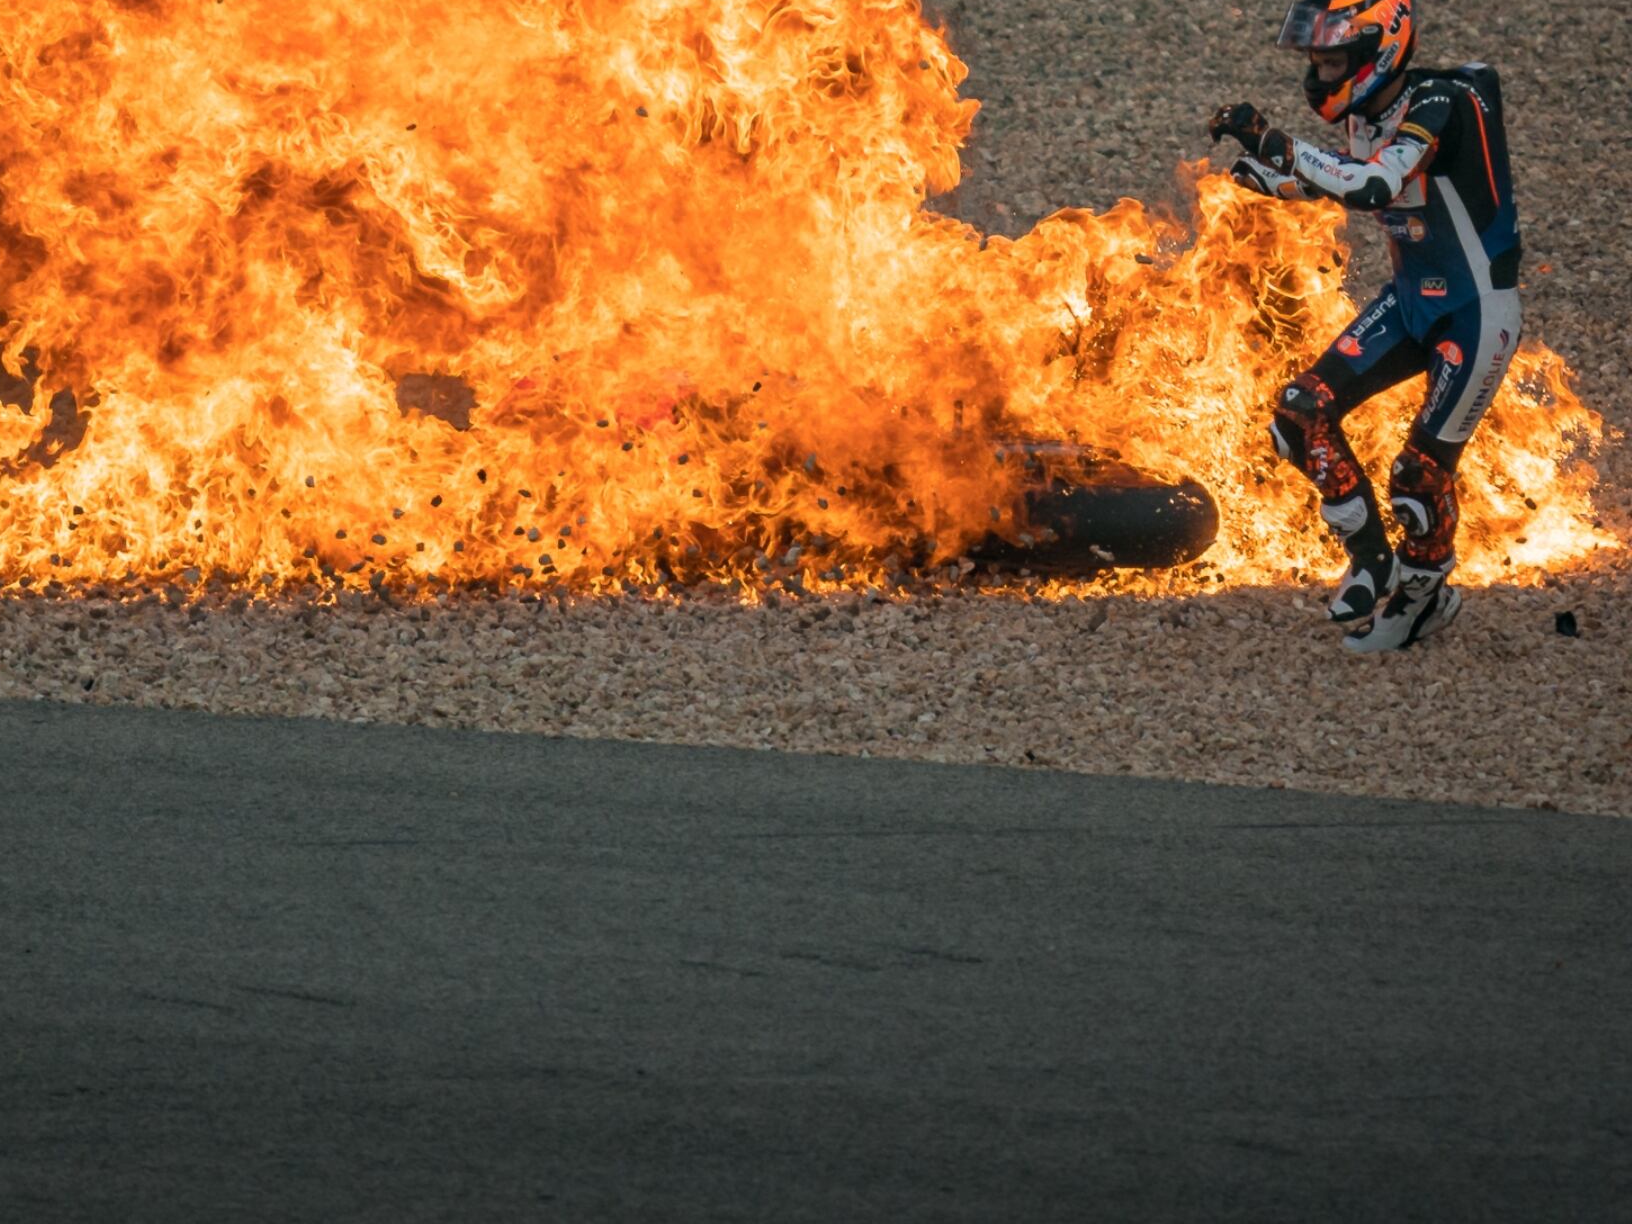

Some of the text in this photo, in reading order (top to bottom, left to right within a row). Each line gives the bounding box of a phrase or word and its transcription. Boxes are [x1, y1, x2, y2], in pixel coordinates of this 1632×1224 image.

[1351, 292, 1398, 338] SUPER
[1421, 365, 1453, 424] SUPER
[1457, 352, 1505, 433] FIETENOLIE
